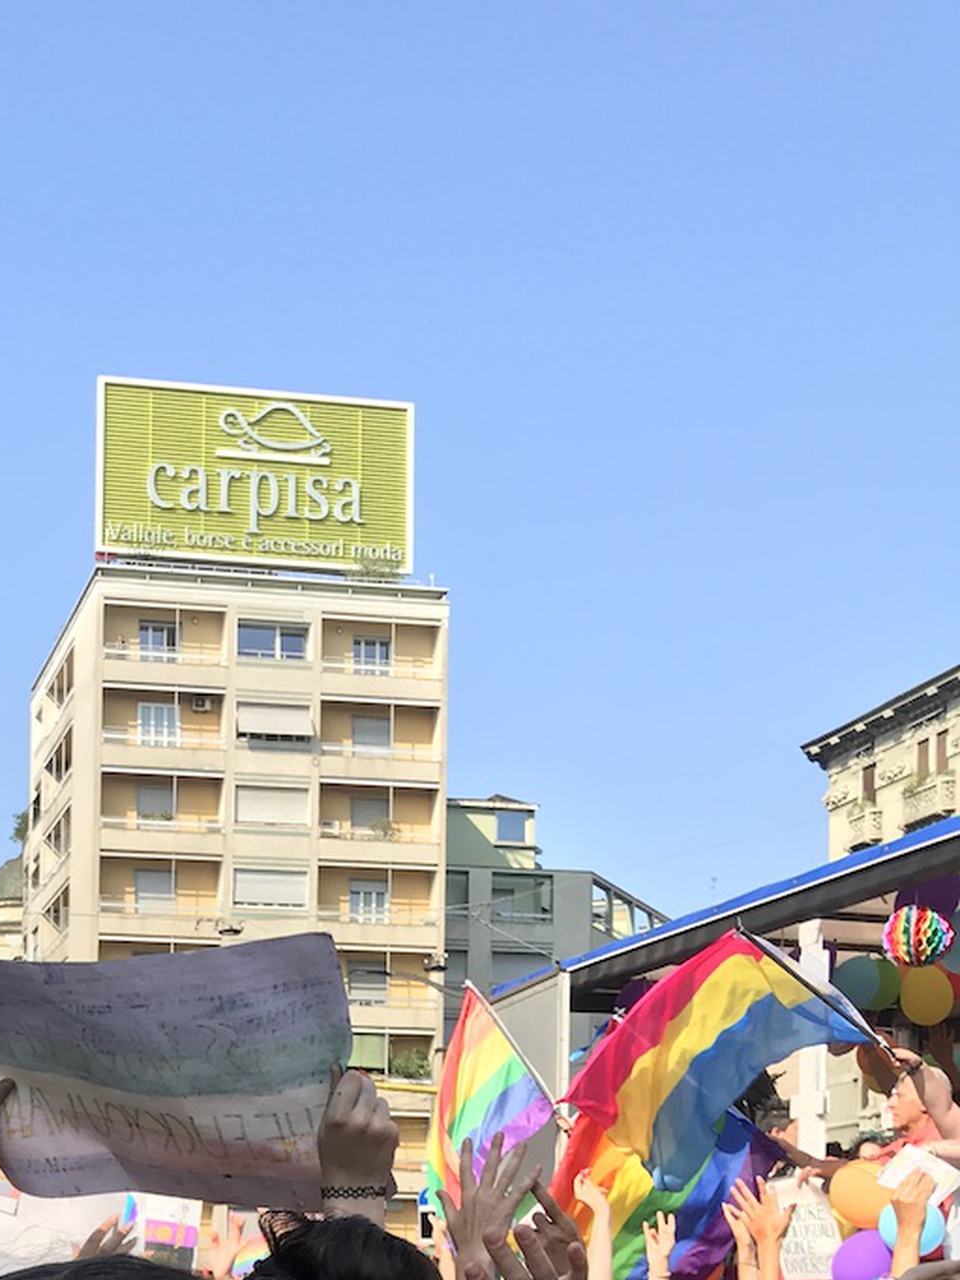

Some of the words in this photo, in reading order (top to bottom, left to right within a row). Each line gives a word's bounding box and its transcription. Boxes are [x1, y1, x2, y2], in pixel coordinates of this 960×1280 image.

[147, 462, 363, 534] carpisa
[185, 525, 235, 549] borse
[259, 537, 345, 557] accessori
[351, 541, 403, 561] moda
